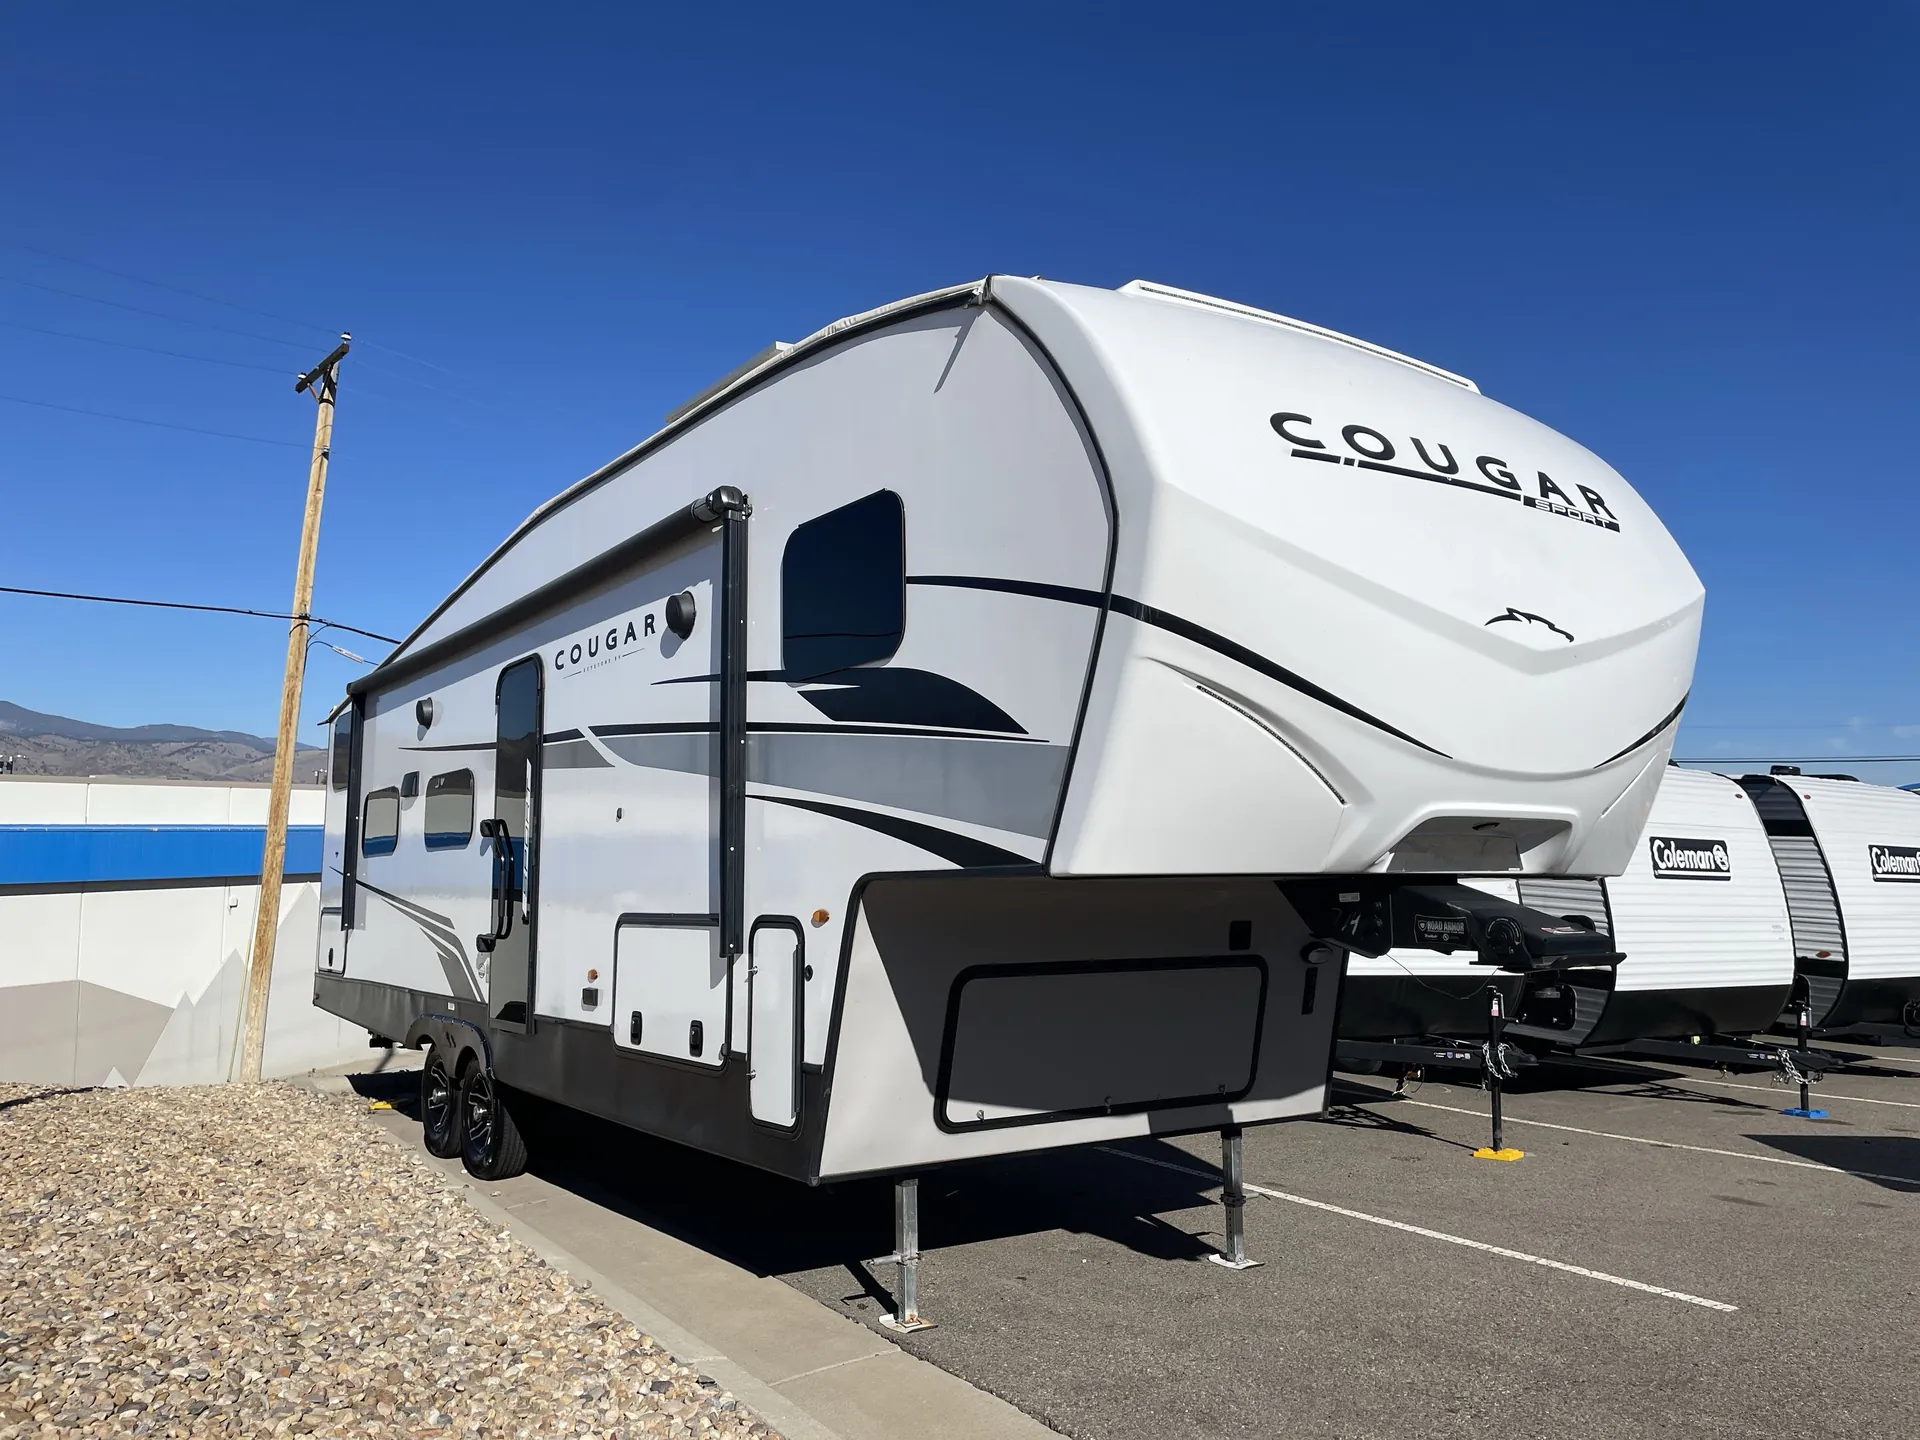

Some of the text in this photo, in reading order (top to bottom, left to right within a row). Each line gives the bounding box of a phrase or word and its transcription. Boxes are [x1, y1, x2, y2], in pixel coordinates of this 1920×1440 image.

[1269, 411, 1620, 521] COUGAR
[1534, 499, 1610, 528] SPORT
[554, 613, 656, 670] COUGAR
[1652, 839, 1715, 871] Coleman
[1871, 846, 1920, 874] Coleman
[1427, 920, 1464, 931] ROAD ARMOR
